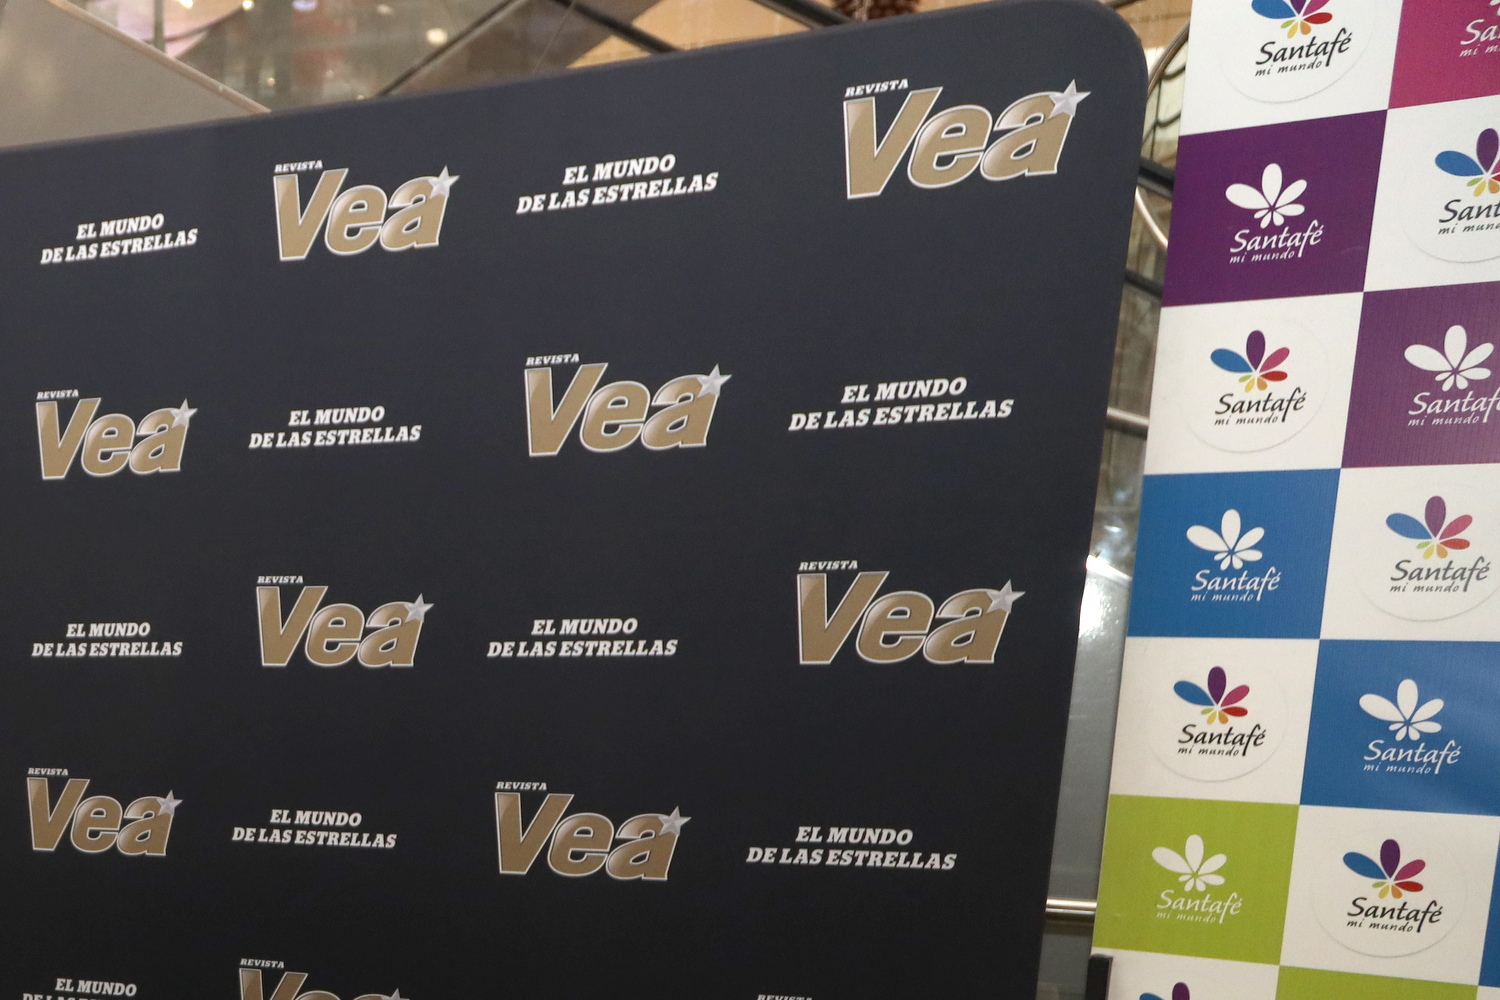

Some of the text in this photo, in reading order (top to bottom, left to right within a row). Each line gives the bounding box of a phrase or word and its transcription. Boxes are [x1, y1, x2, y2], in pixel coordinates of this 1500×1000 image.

[1255, 27, 1352, 67] Santafé
[1255, 58, 1323, 77] mi mundo
[845, 79, 908, 96] REVISTA
[842, 86, 1076, 198] Vea
[563, 154, 675, 184] EL MUNDO
[516, 173, 718, 212] DE LAS ESTRELLAS
[1230, 219, 1324, 257] Santafé
[1229, 246, 1295, 264] mi mundo
[525, 353, 578, 366] REVISTA
[841, 377, 966, 403] EL MUNDO
[524, 362, 720, 456] Vea
[788, 399, 1013, 430] DE LAS ESTRELLAS
[1215, 387, 1306, 423] Santafé
[1214, 412, 1278, 426] mi mundo
[1408, 412, 1479, 426] mi mundo
[798, 560, 857, 570] REVISTA
[1390, 556, 1490, 592] Santafé
[257, 575, 302, 584] REVISTA
[1191, 566, 1281, 602] Santafé
[1390, 581, 1460, 593] mi mundo
[1191, 591, 1208, 602] mi
[66, 622, 150, 637] EL MUNDO
[255, 585, 425, 667] Vea
[796, 571, 1012, 664] Vea
[31, 641, 183, 656] DE LAS ESTRELLAS
[1177, 744, 1239, 757] mi mundo
[1178, 724, 1266, 757] Santafé
[1363, 739, 1461, 774] Santafé
[1363, 761, 1431, 774] mi mundo
[27, 767, 67, 776] REVISTA
[26, 776, 175, 857] Vea
[796, 826, 913, 845] EL MUNDO
[746, 846, 957, 869] DE LAS ESTRELLAS
[1156, 889, 1242, 924] Santafé
[1347, 897, 1442, 933] Santafé
[1347, 918, 1413, 933] mi mundo
